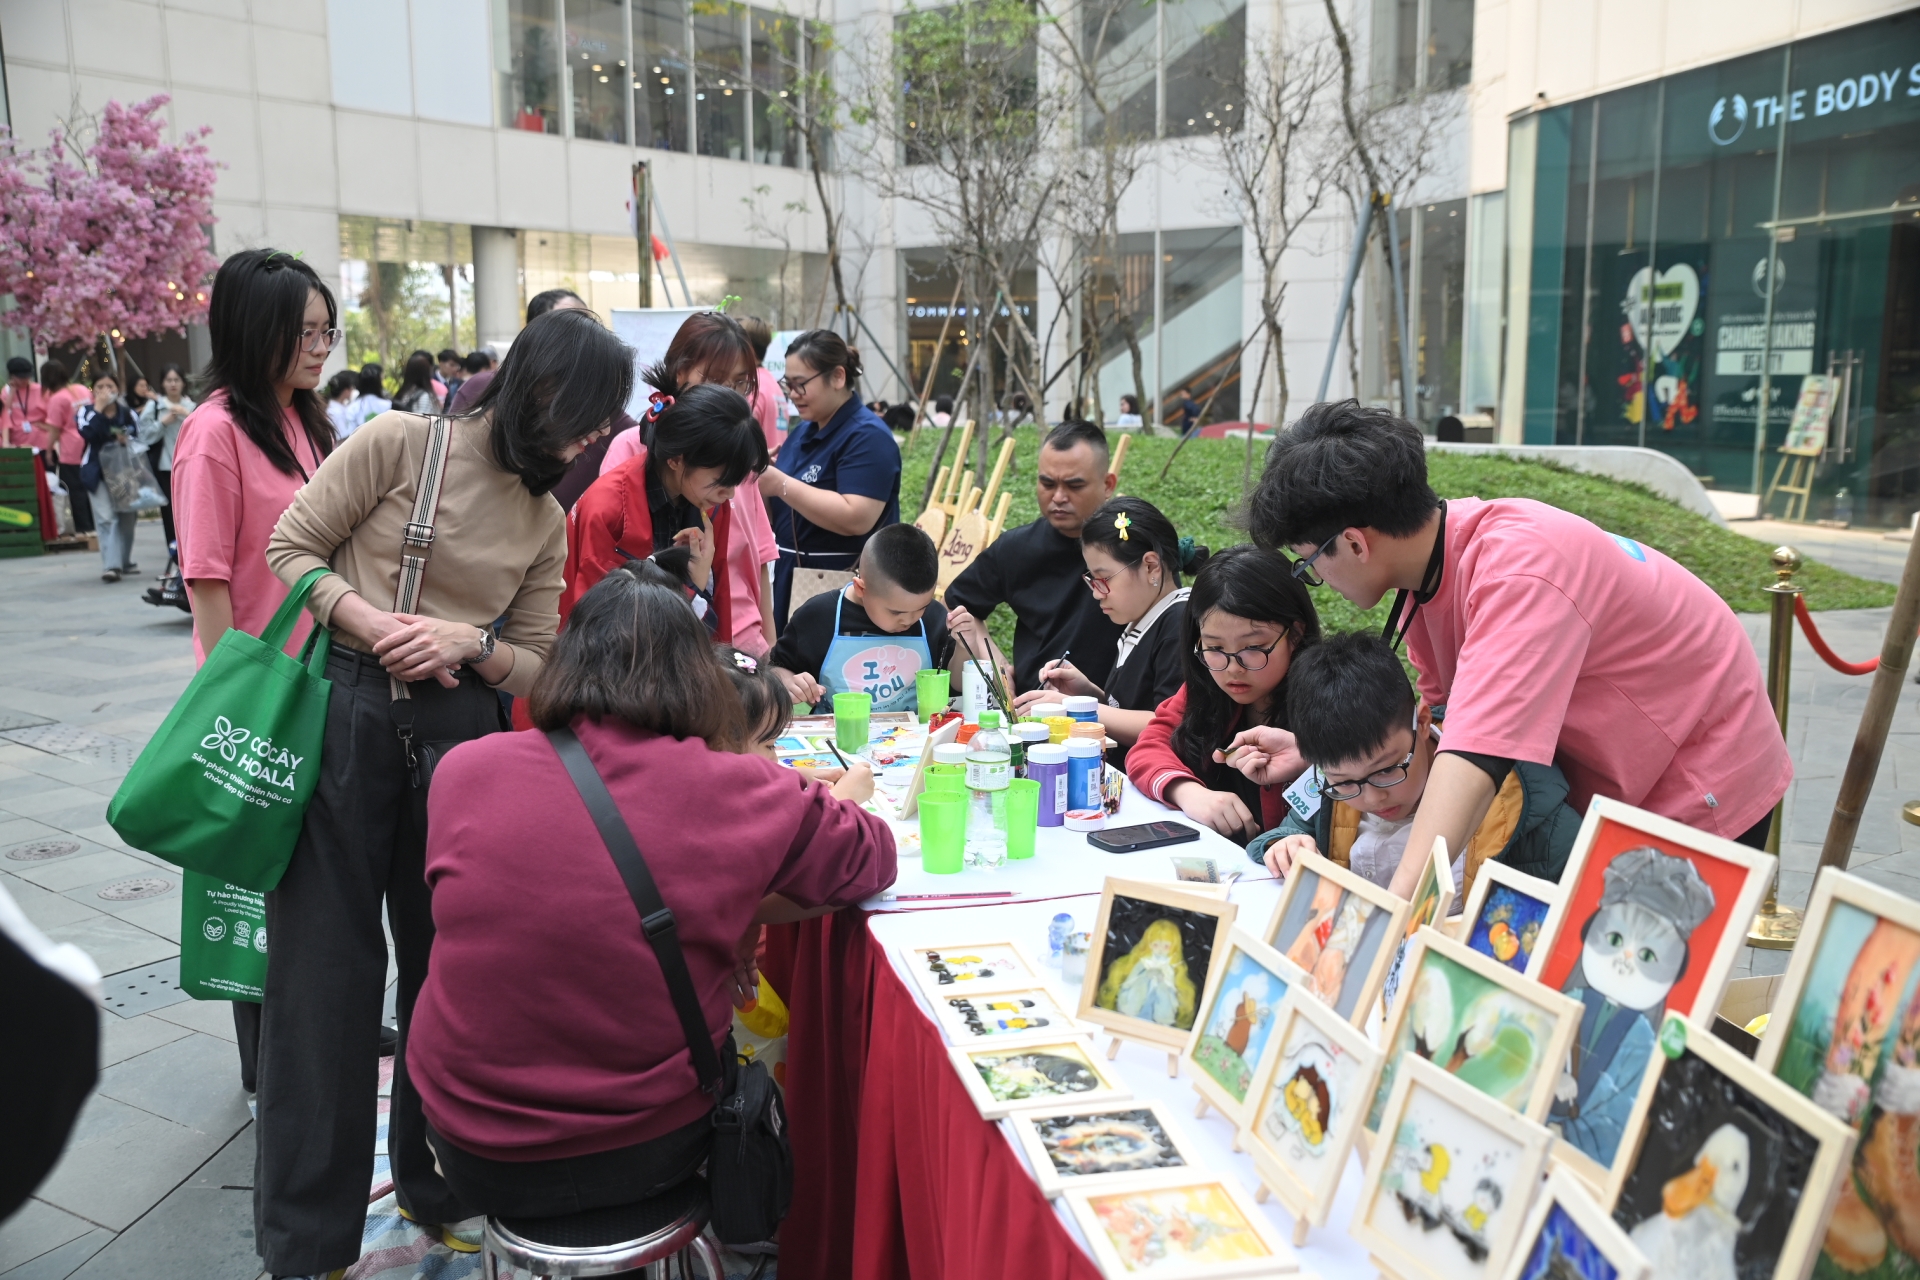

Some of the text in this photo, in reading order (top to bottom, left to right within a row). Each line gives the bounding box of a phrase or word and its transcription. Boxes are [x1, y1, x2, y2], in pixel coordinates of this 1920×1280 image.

[1753, 89, 1807, 130] THE
[1814, 66, 1902, 117] BODY
[1717, 322, 1815, 350] CHANGEAKING
[1743, 353, 1784, 372] BEATY
[863, 662, 880, 680] I
[1287, 791, 1310, 815] 2025
